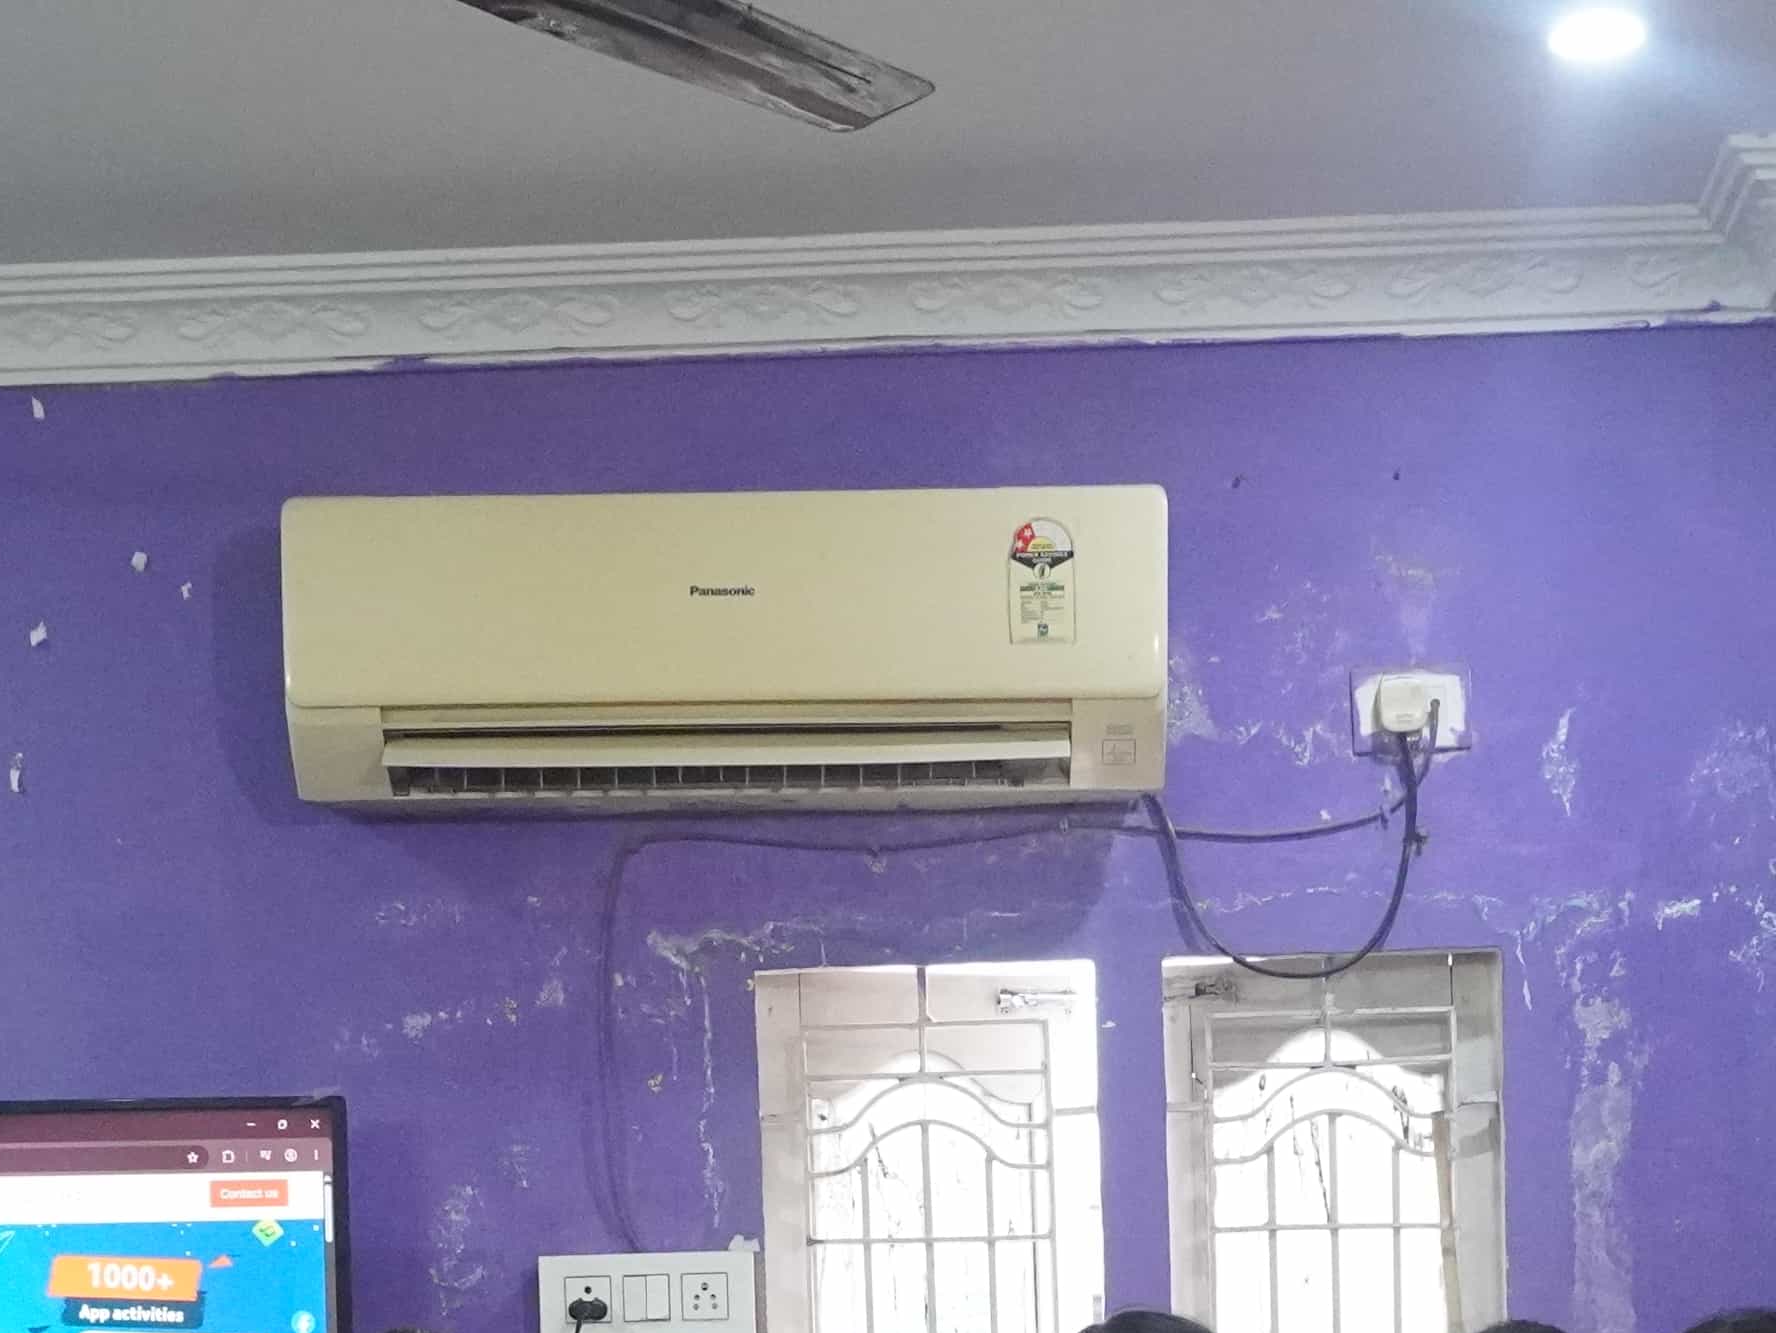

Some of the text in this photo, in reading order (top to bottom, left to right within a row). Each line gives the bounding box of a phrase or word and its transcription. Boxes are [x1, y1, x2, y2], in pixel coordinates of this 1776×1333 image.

[689, 585, 755, 597] Panasonic
[87, 1262, 174, 1291] 1000+
[78, 1304, 185, 1323] App activities
